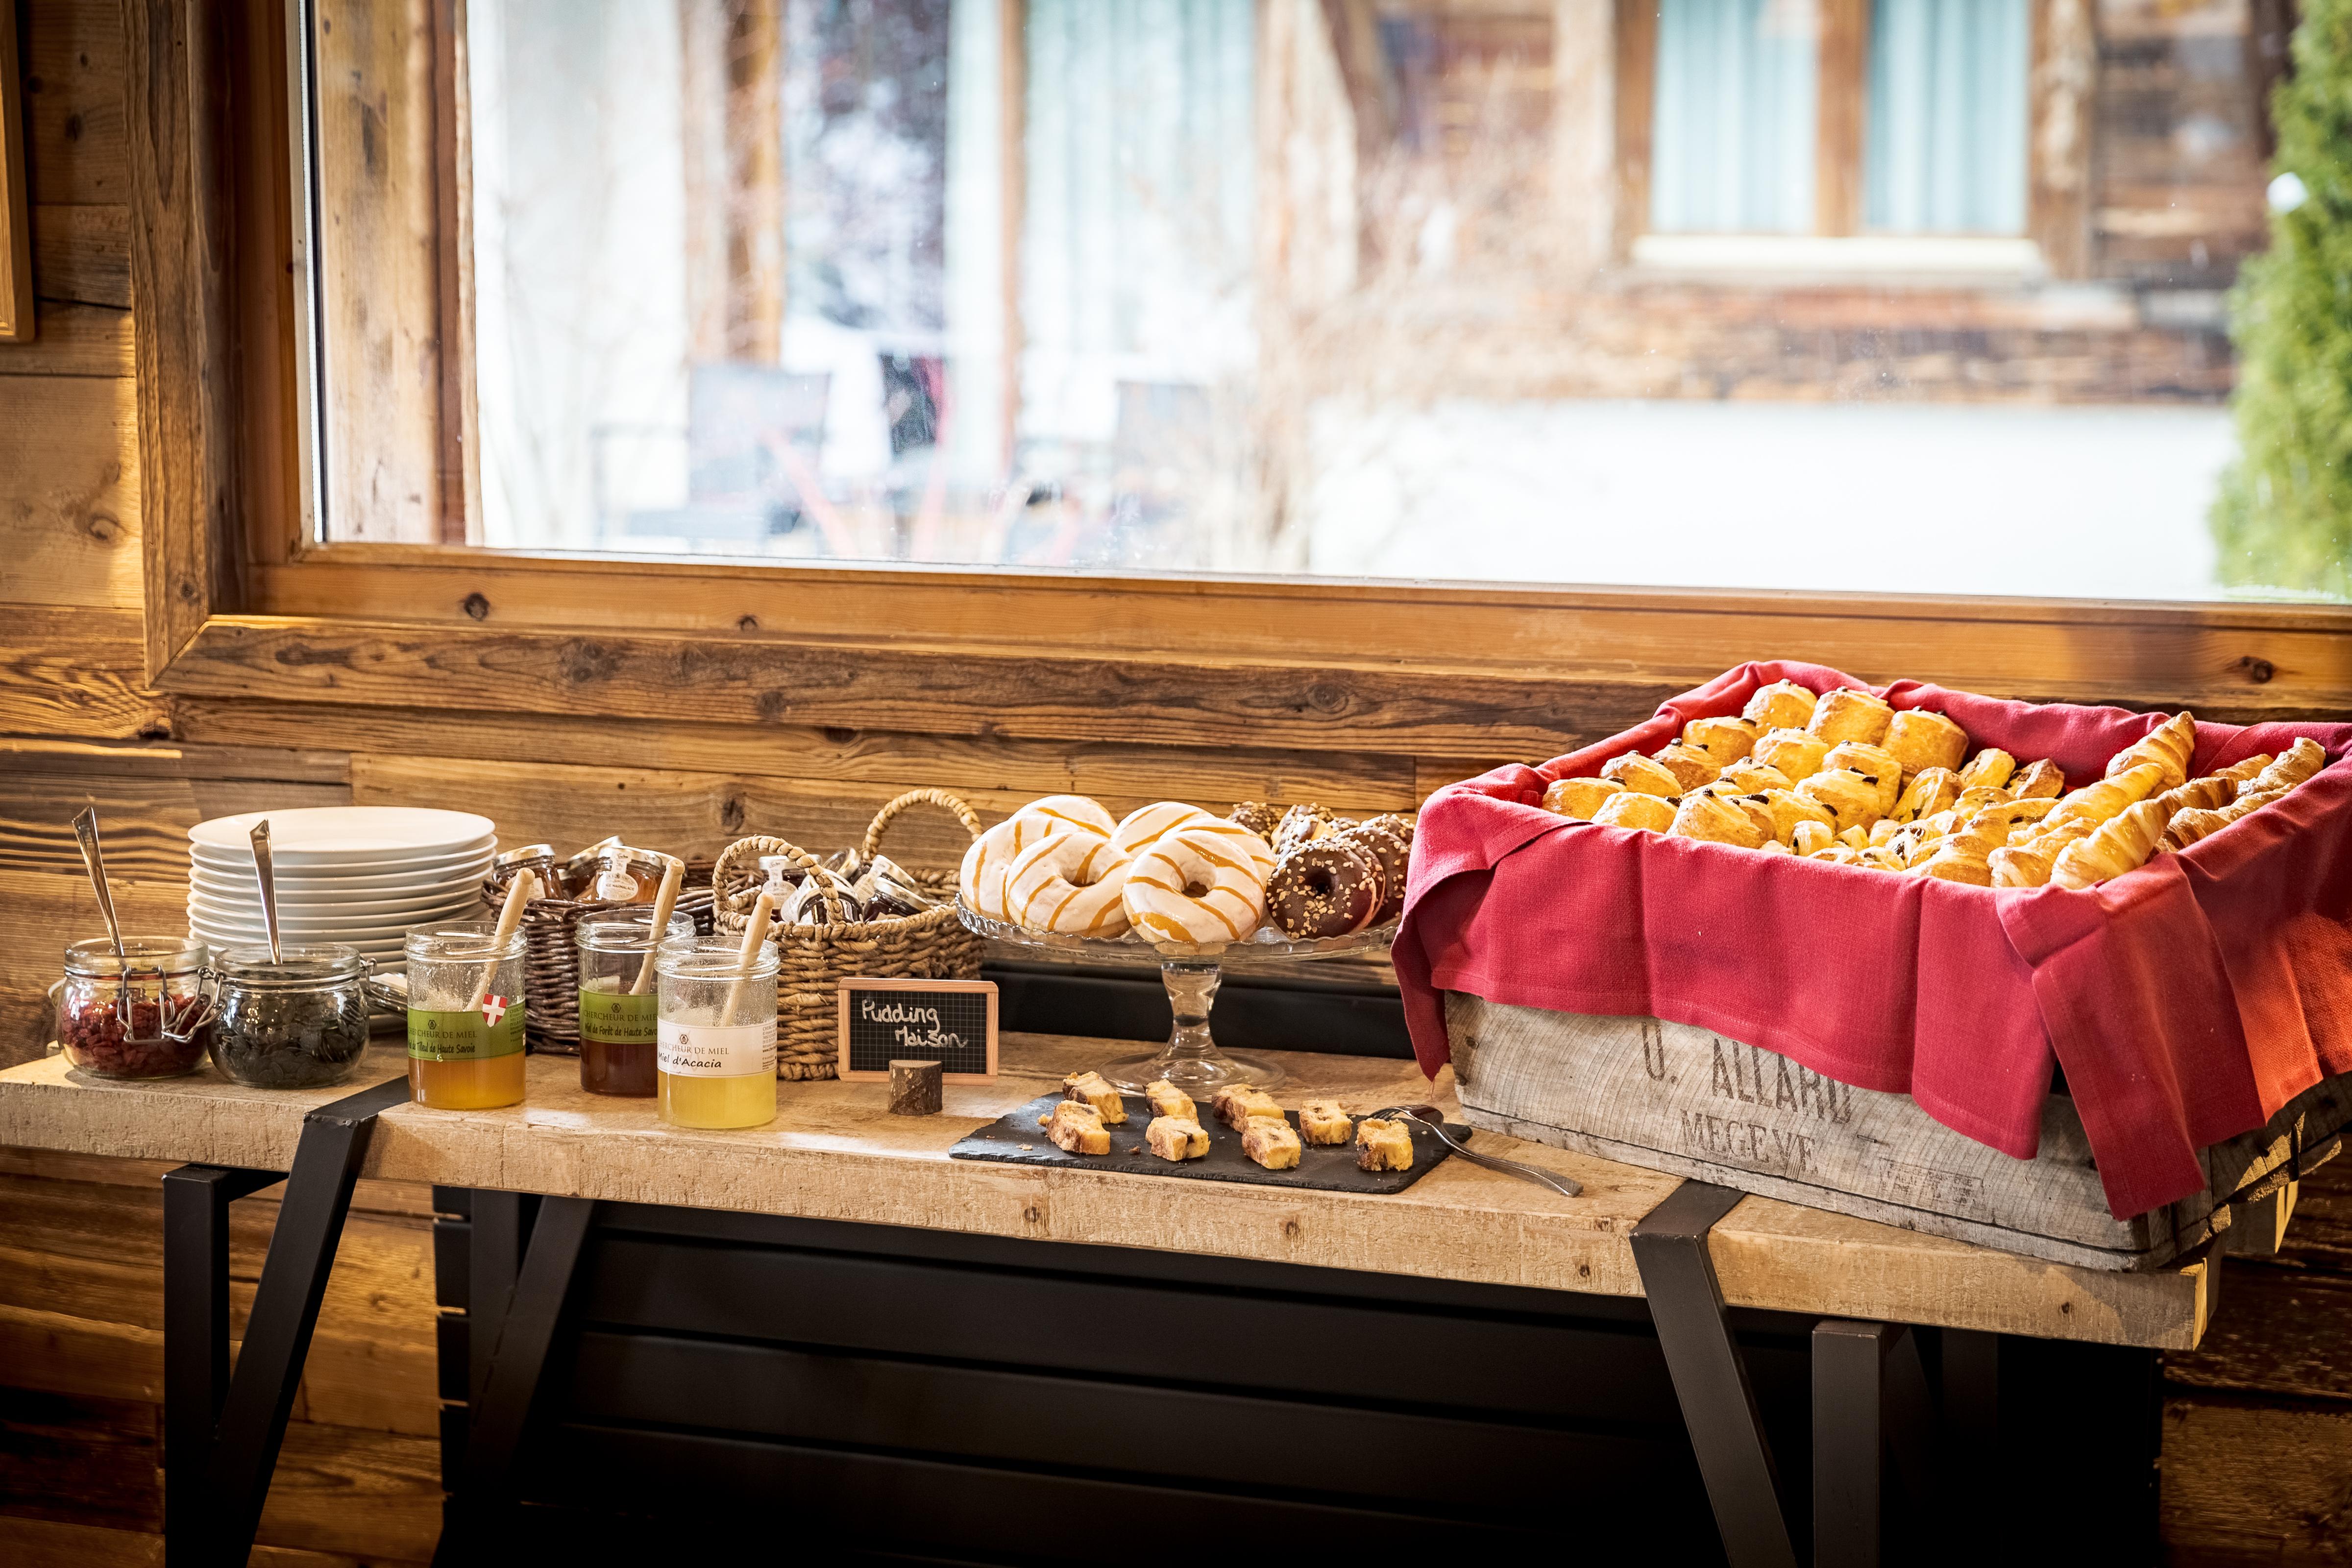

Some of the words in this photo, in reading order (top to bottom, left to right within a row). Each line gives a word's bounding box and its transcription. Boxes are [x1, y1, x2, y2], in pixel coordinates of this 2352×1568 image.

[583, 1009, 625, 1021] CHERCHEUR
[862, 998, 940, 1033] Pudding
[592, 1024, 598, 1034] de
[599, 1025, 613, 1036] Forêt
[614, 1026, 622, 1036] de
[624, 1027, 642, 1036] Haute
[644, 1027, 658, 1037] Savo
[895, 1025, 968, 1048] Maison
[416, 1041, 429, 1053] Tilleul
[429, 1042, 436, 1053] de
[437, 1044, 455, 1054] Haute
[456, 1043, 476, 1054] Savoie
[658, 1039, 692, 1054] CHERCHEUR
[658, 1052, 670, 1063] Miel
[673, 1056, 722, 1068] d'Acacia
